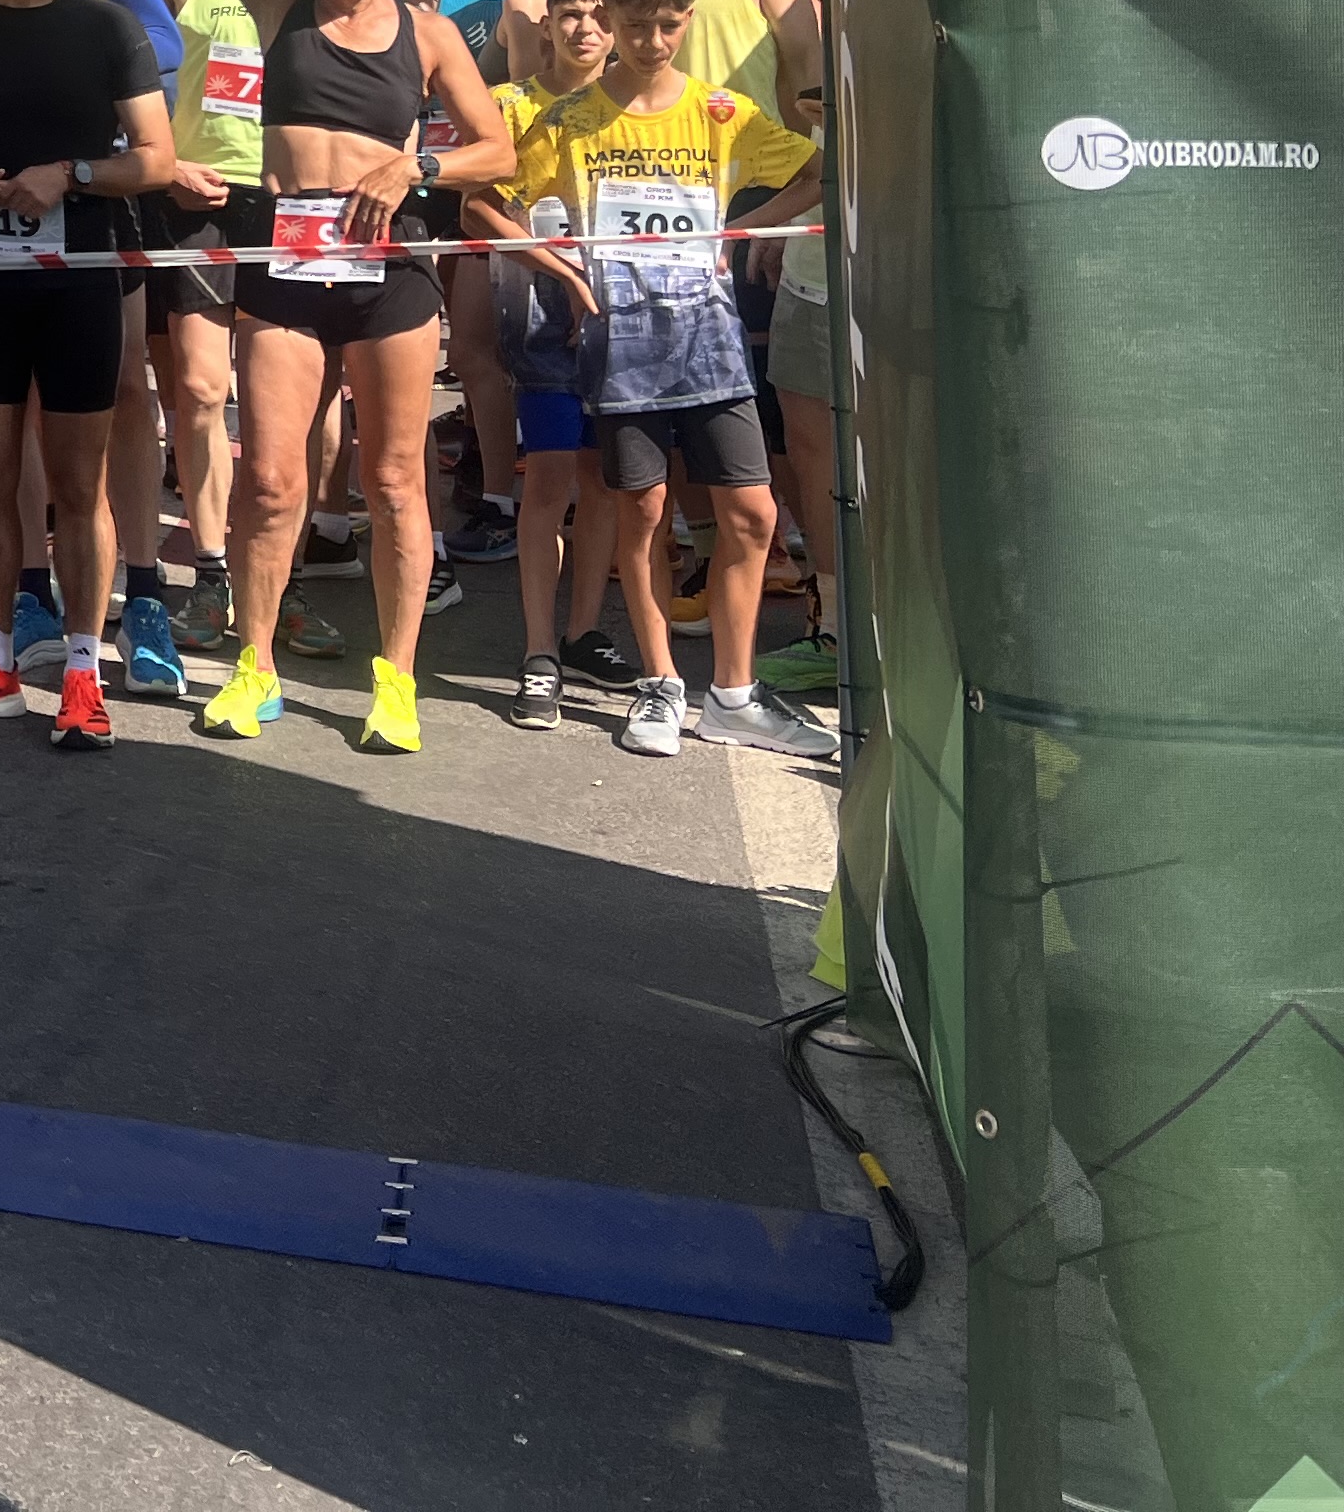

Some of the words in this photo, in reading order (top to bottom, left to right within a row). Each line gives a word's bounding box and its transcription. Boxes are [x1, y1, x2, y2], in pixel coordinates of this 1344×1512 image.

[236, 71, 264, 101] 7
[1132, 140, 1320, 170] NOIBRODAM.RO
[618, 210, 694, 245] 309
